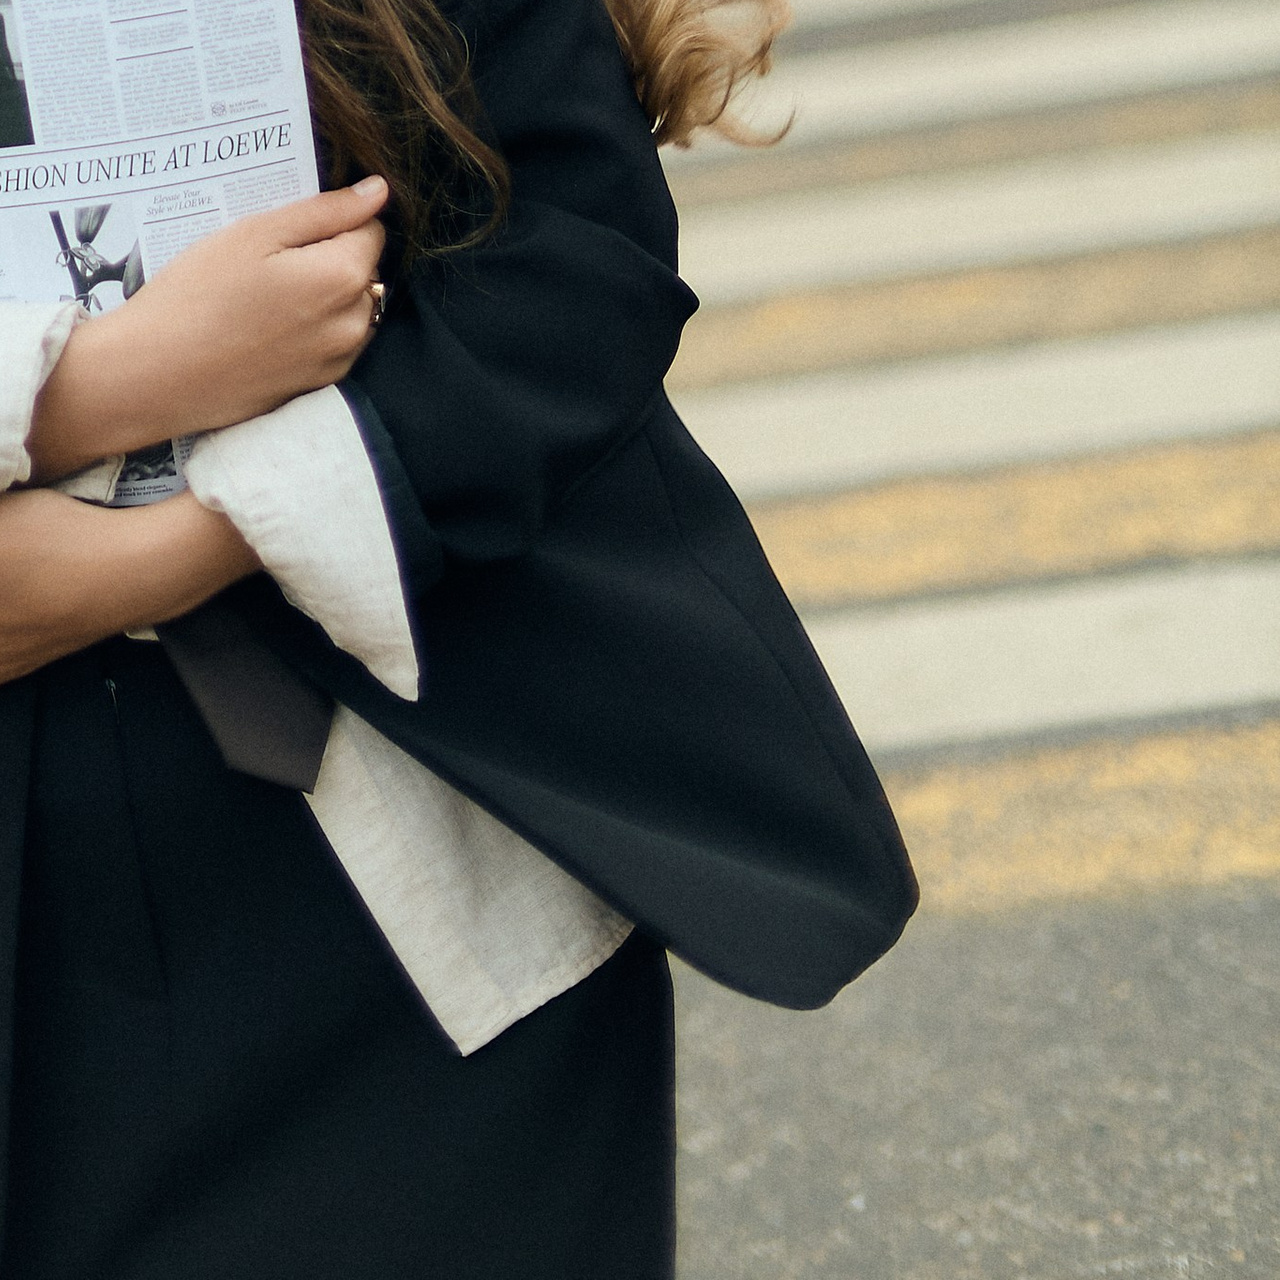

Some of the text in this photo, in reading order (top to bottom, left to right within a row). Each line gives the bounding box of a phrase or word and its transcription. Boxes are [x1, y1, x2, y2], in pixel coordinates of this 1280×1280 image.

[76, 150, 157, 184] UNITE
[162, 143, 196, 172] AT
[202, 123, 292, 165] LOEWE
[153, 190, 200, 205] Elevate Your
[146, 205, 166, 217] Style
